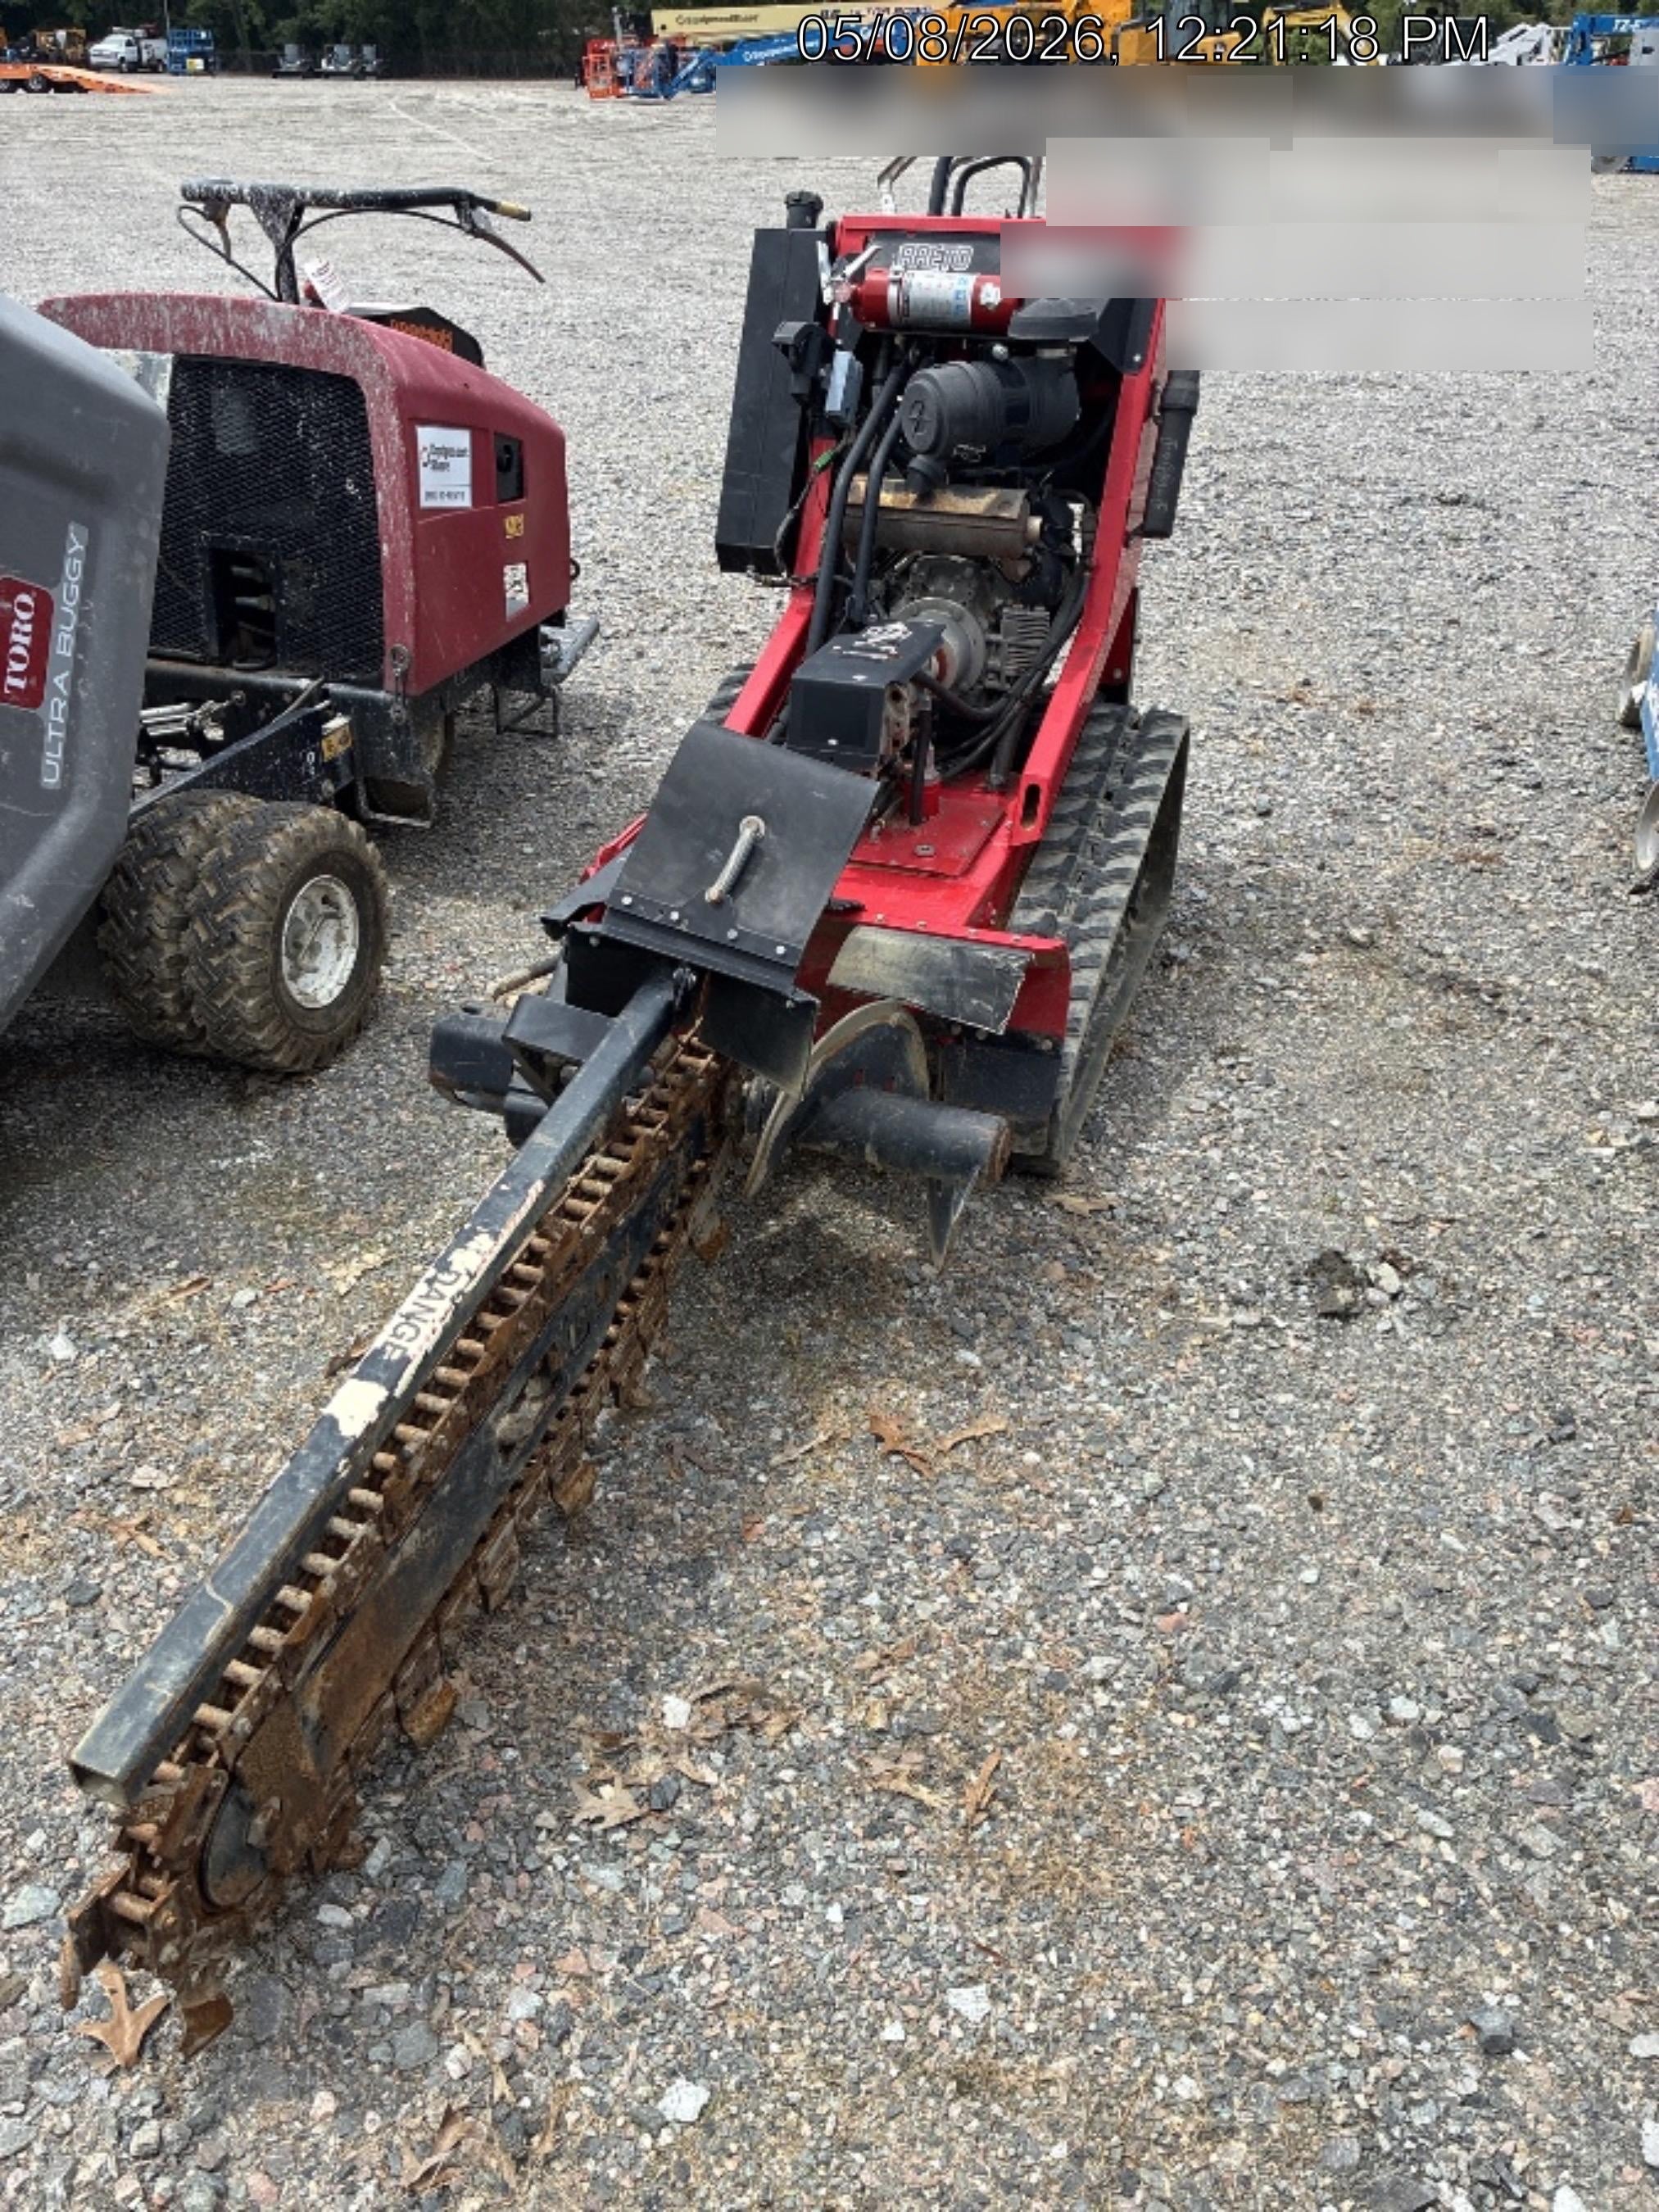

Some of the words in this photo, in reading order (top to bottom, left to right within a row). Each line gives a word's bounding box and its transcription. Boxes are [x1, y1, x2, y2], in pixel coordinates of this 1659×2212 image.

[5, 592, 35, 695] TORO
[43, 670, 70, 783] ULTRA
[57, 531, 84, 657] BUGGY
[383, 1270, 463, 1360] DANGE
